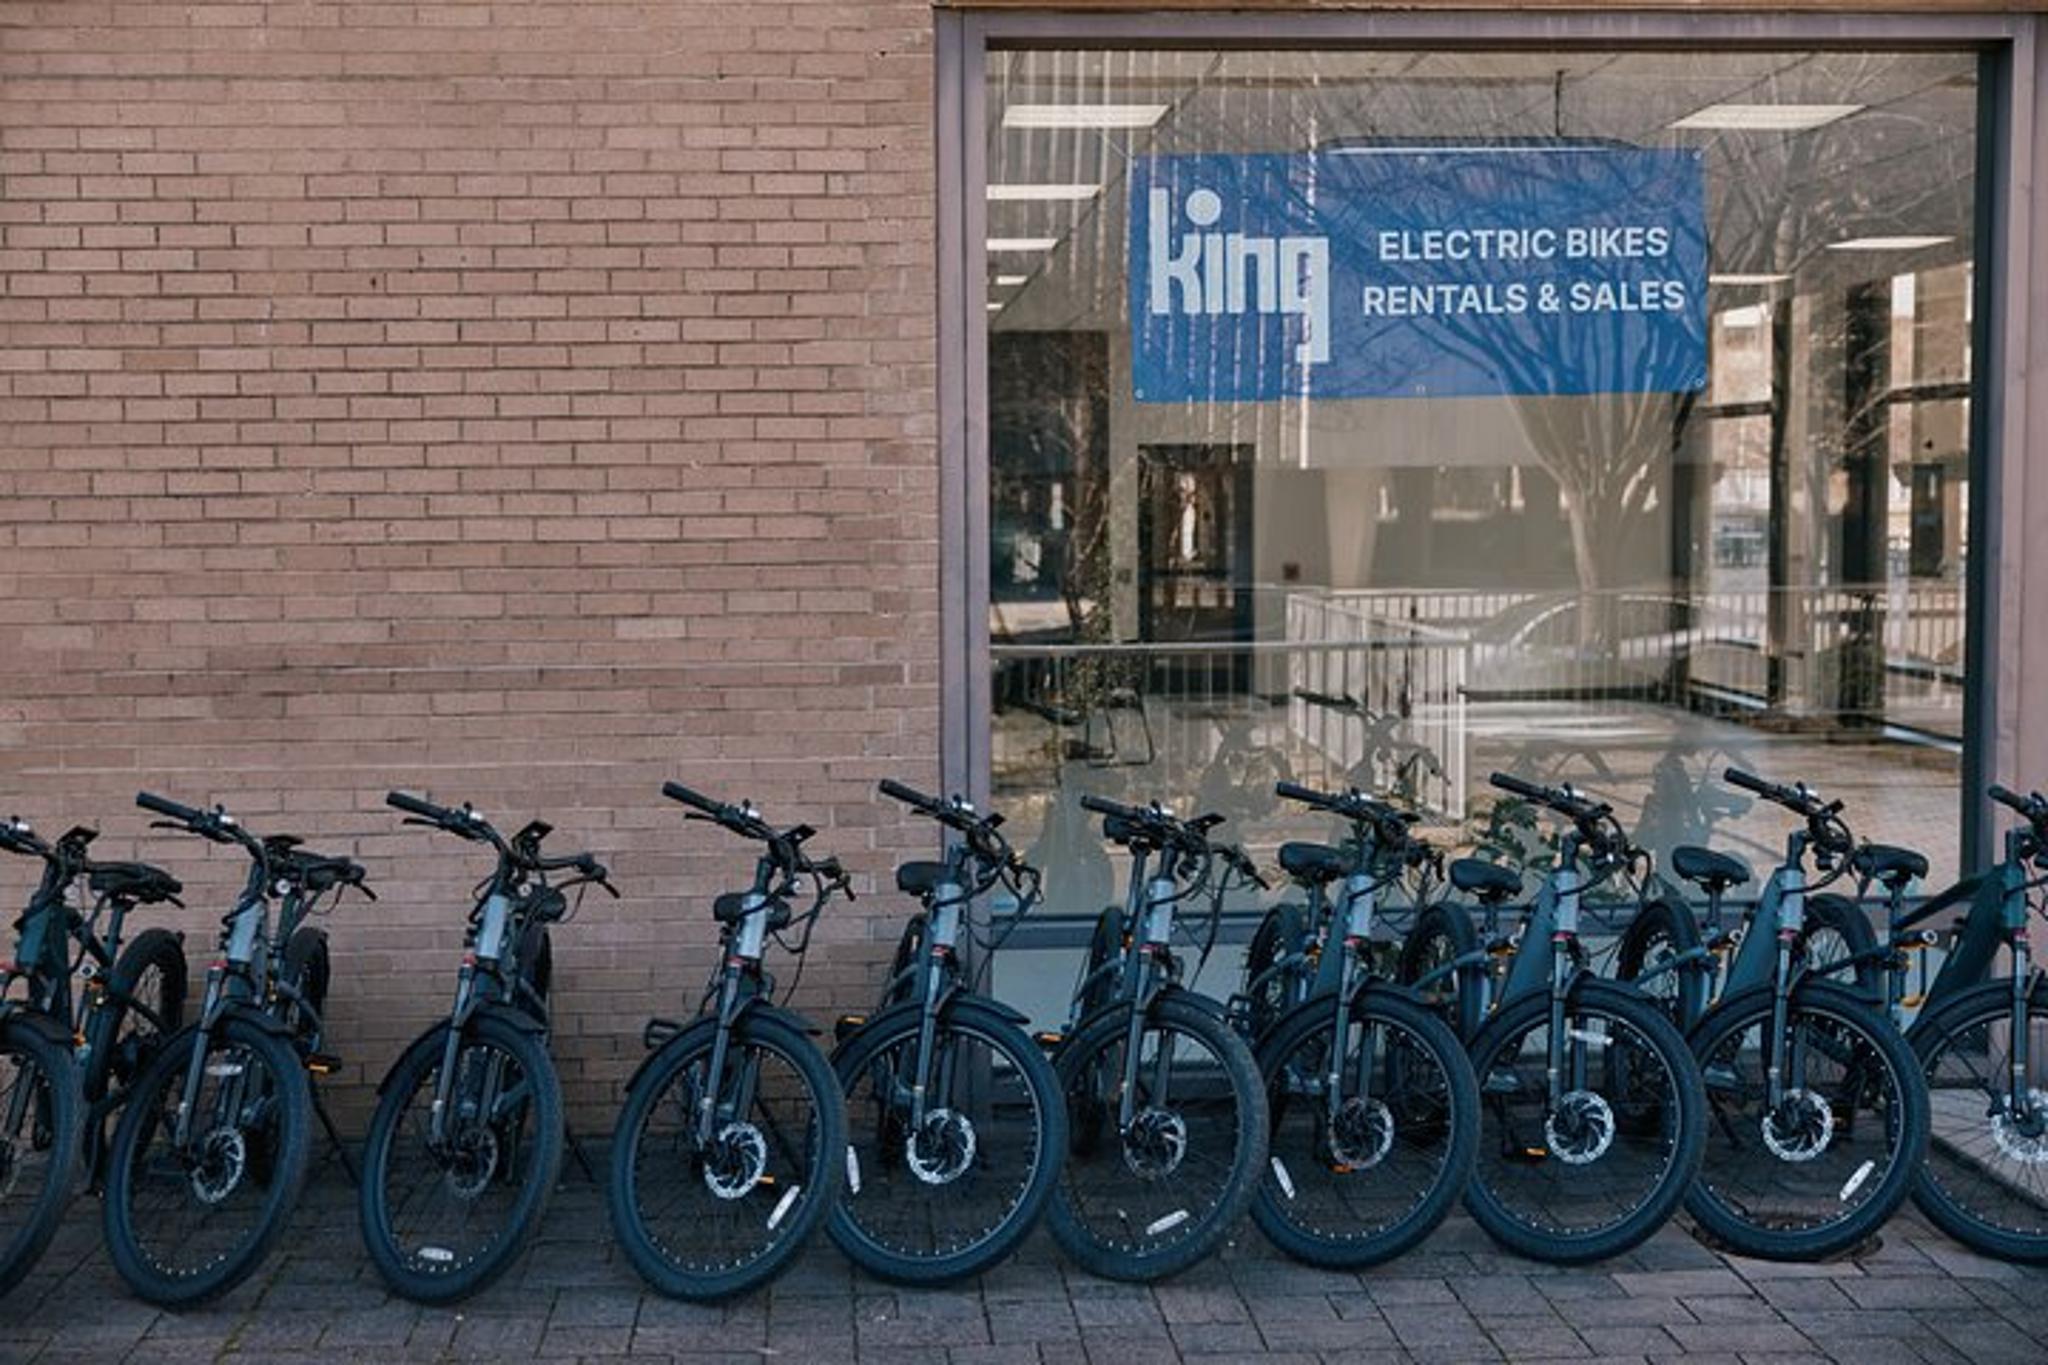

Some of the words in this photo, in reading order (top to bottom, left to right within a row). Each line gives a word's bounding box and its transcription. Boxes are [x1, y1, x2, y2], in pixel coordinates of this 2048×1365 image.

[1379, 229, 1556, 261] ELECTRIC
[1566, 227, 1669, 258] BIKES
[1149, 188, 1329, 362] king
[1362, 284, 1528, 316] RENTALS
[1537, 284, 1560, 312] &
[1570, 280, 1686, 311] SALES
